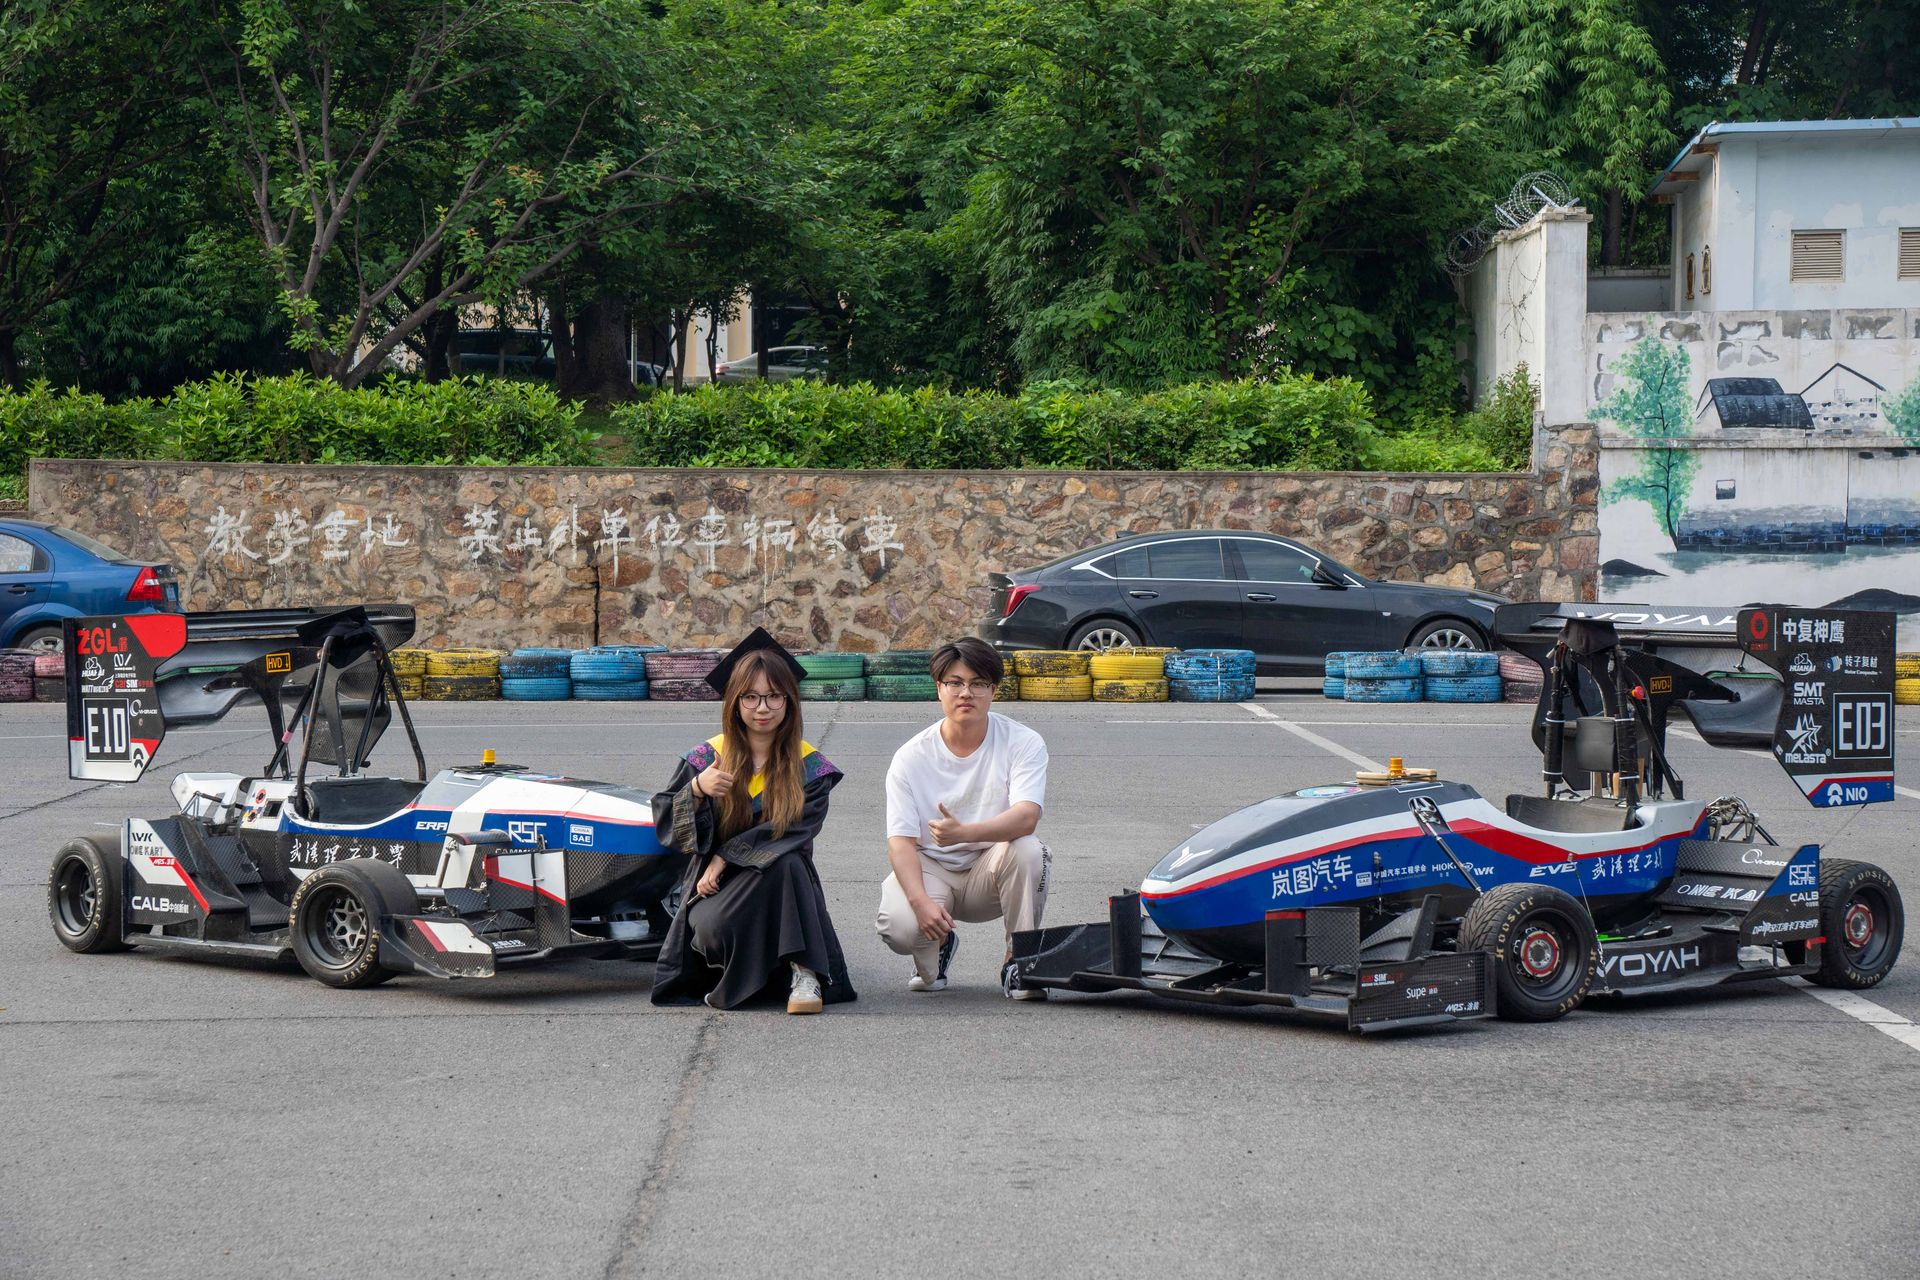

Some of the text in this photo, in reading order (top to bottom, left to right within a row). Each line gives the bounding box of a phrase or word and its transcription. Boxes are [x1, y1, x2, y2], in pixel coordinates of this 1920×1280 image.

[1782, 618, 1845, 644] 中复神鹰
[77, 627, 118, 655] ZGL
[269, 657, 283, 669] HVD
[1652, 680, 1667, 692] HVD
[1794, 682, 1825, 697] SMT
[1794, 698, 1825, 706] MASTA
[1846, 787, 1868, 801] NIO
[572, 834, 591, 843] SAE
[1432, 862, 1457, 873] HIOK
[1529, 861, 1577, 878] EVE
[1271, 854, 1353, 900] 岚图汽车
[131, 896, 170, 912] CALB
[1790, 891, 1820, 903] CALB
[1596, 945, 1700, 978] VOYAH
